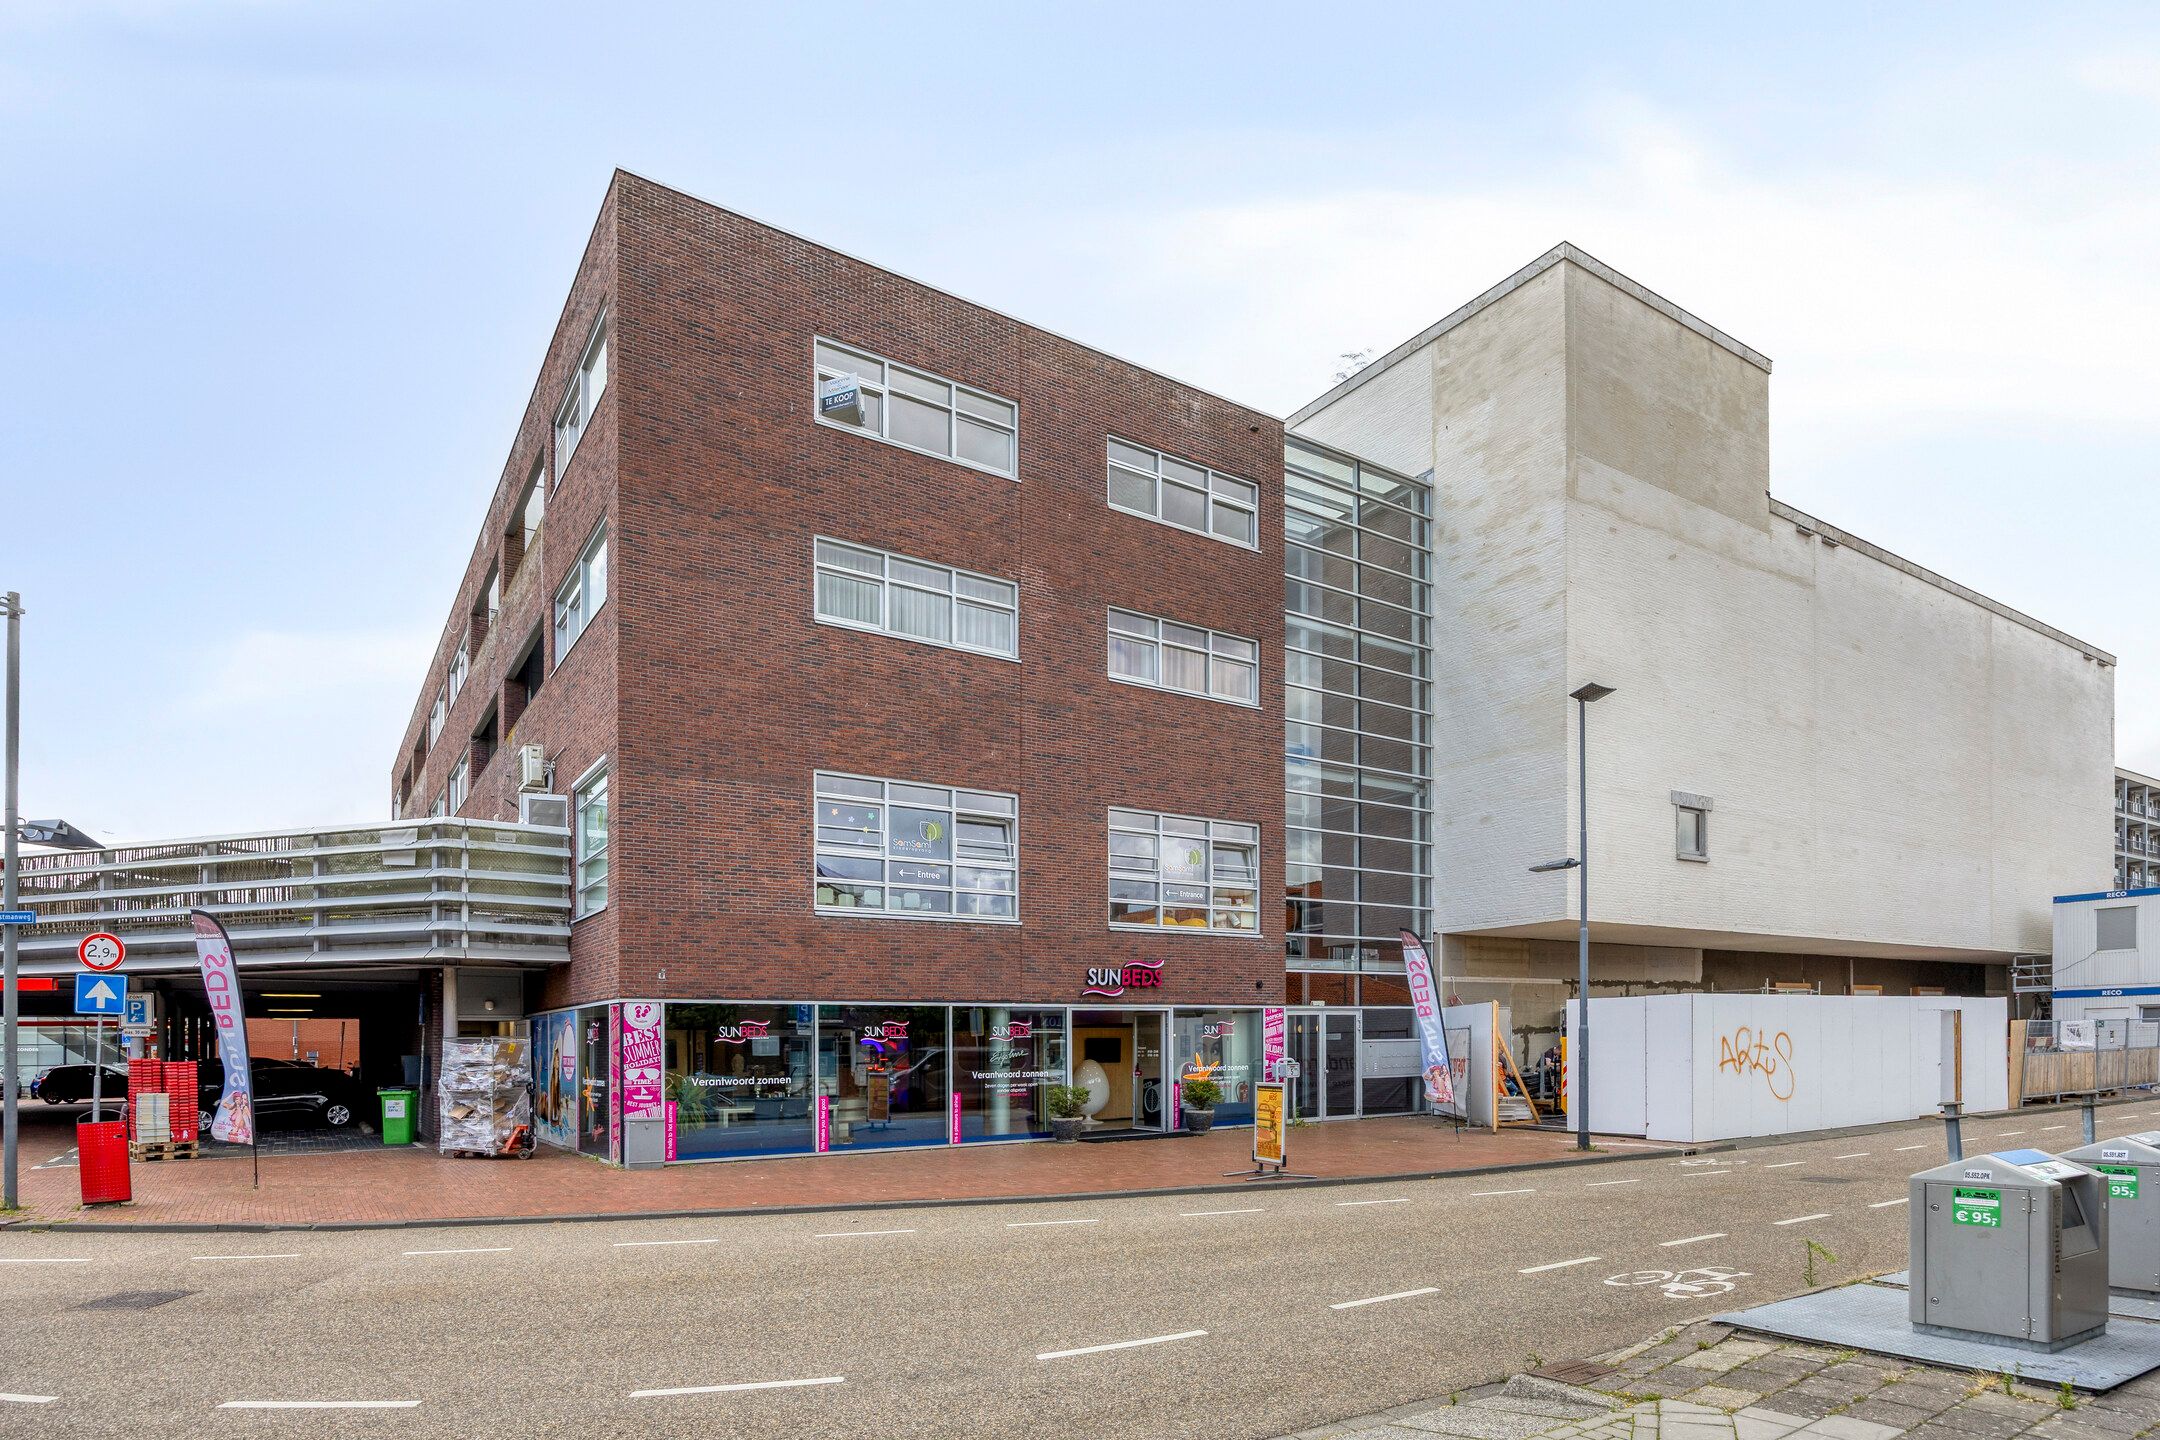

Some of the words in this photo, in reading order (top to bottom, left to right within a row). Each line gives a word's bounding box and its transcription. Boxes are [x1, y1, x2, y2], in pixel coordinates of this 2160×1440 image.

[825, 398, 833, 406] TE
[834, 392, 854, 404] KOOP
[917, 870, 940, 880] Entree
[1180, 890, 1204, 899] Entrance
[1087, 968, 1163, 987] SUNBEDS
[623, 1025, 661, 1047] BEST
[719, 1026, 768, 1037] SUNBEDS
[864, 1026, 907, 1037] SUNBEDS
[992, 1026, 1030, 1037] SUNBEDS
[623, 1040, 661, 1063] SUMMER
[1188, 1064, 1227, 1072] Verantwoord
[971, 1070, 1021, 1079] Verantwoord
[691, 1077, 755, 1086] Verantwoord
[757, 1076, 792, 1084] zonnen
[820, 1142, 826, 1150] We
[1955, 1210, 1969, 1222] €
